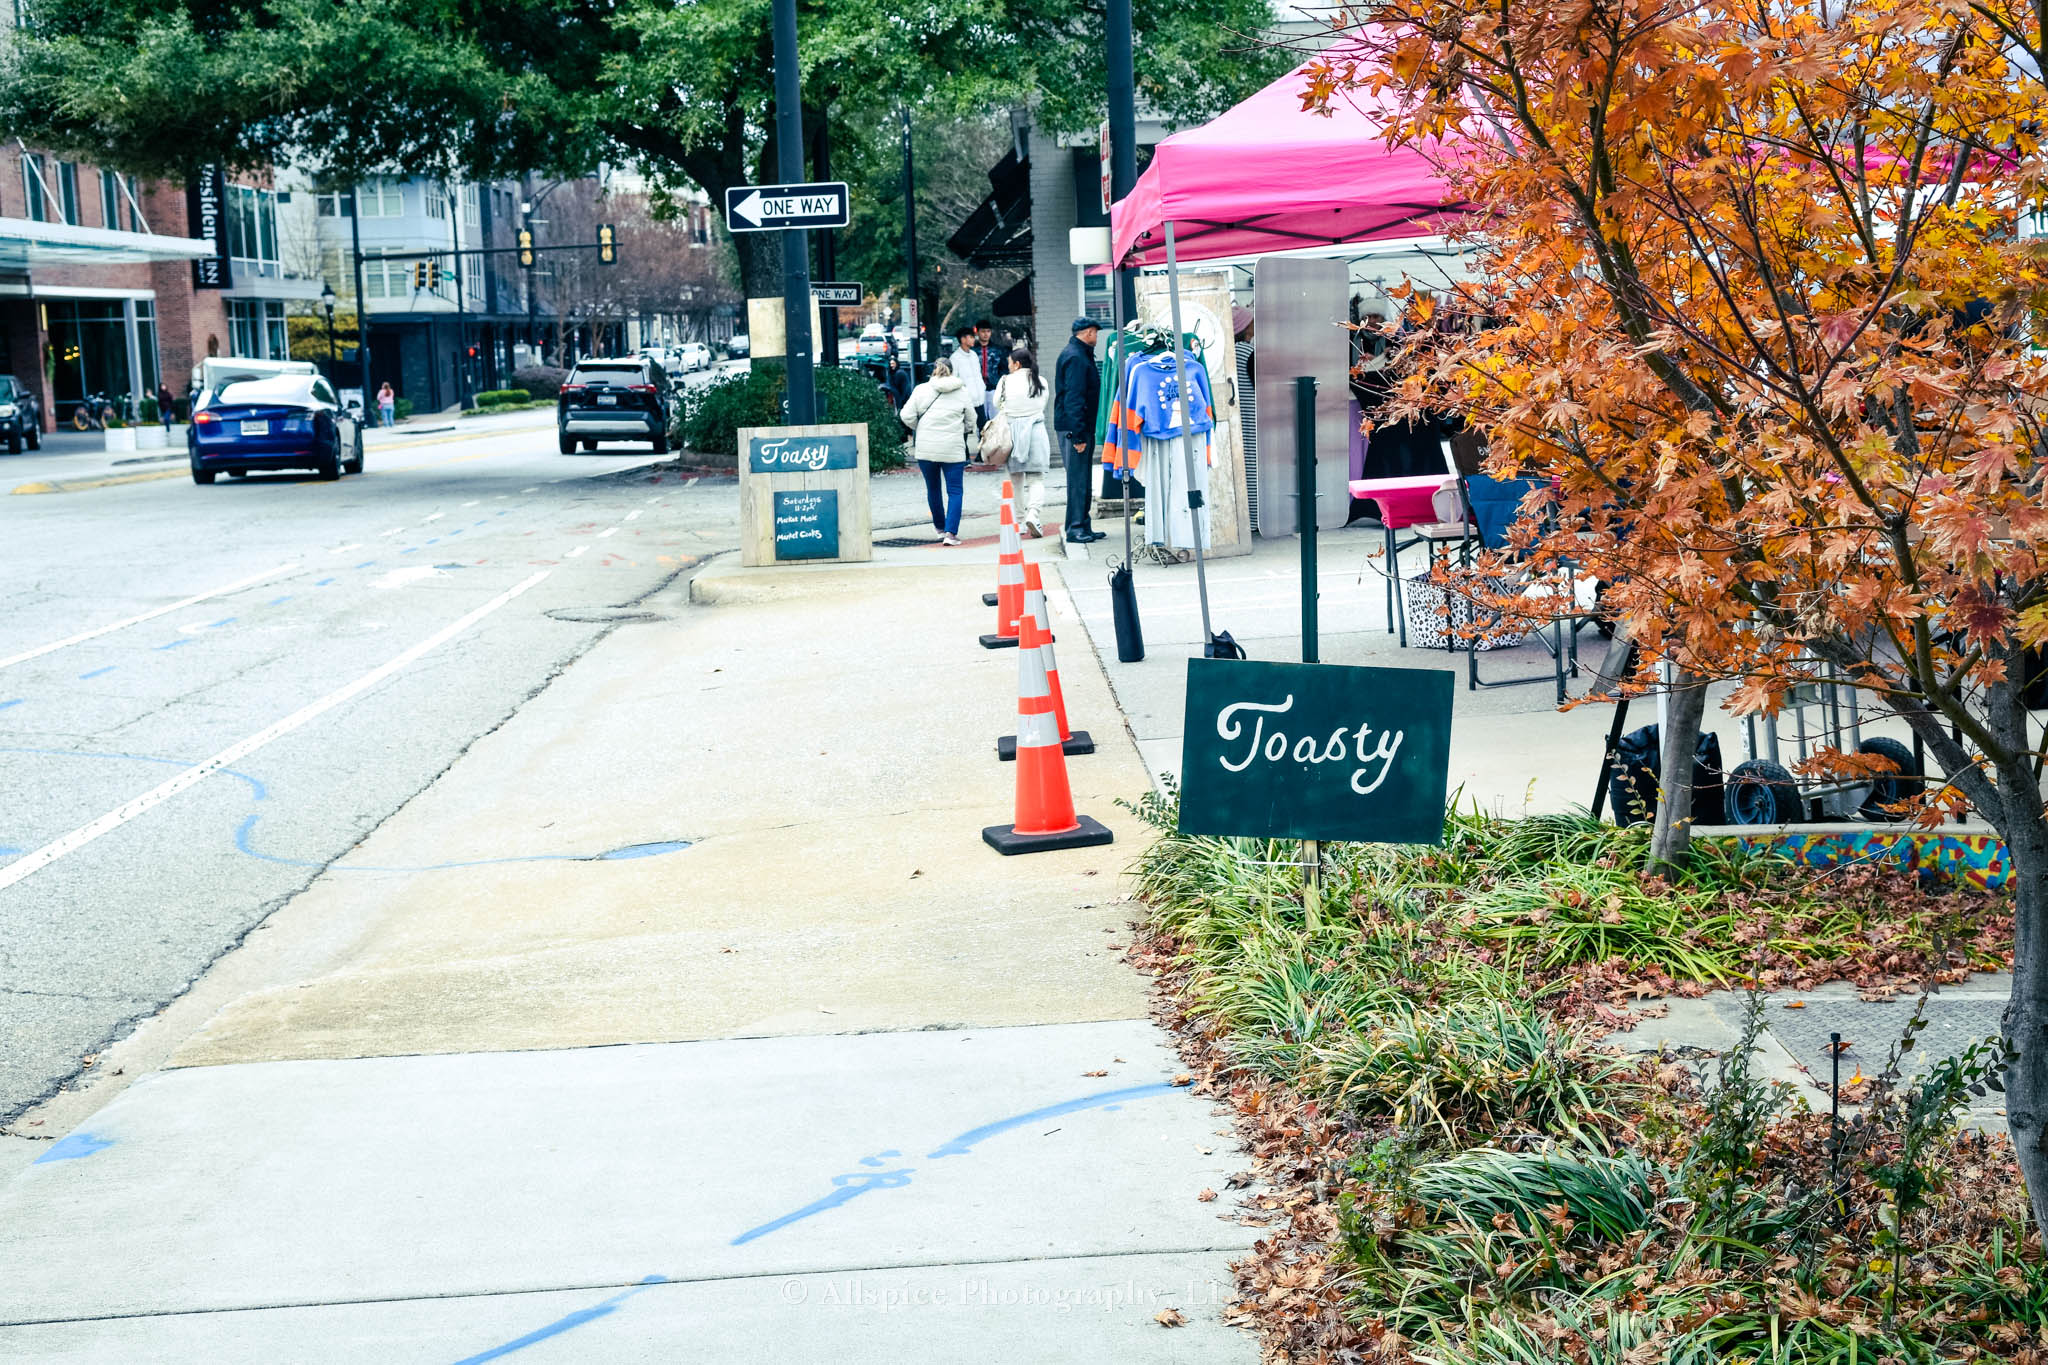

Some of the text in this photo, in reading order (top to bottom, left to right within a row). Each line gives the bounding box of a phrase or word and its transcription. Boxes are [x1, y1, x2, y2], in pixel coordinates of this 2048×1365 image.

[763, 197, 833, 216] ONE WAY
[205, 261, 220, 284] INN
[834, 289, 854, 299] WAY
[760, 438, 829, 470] Toasty
[776, 531, 798, 542] Market
[1217, 694, 1404, 794] Toasty
